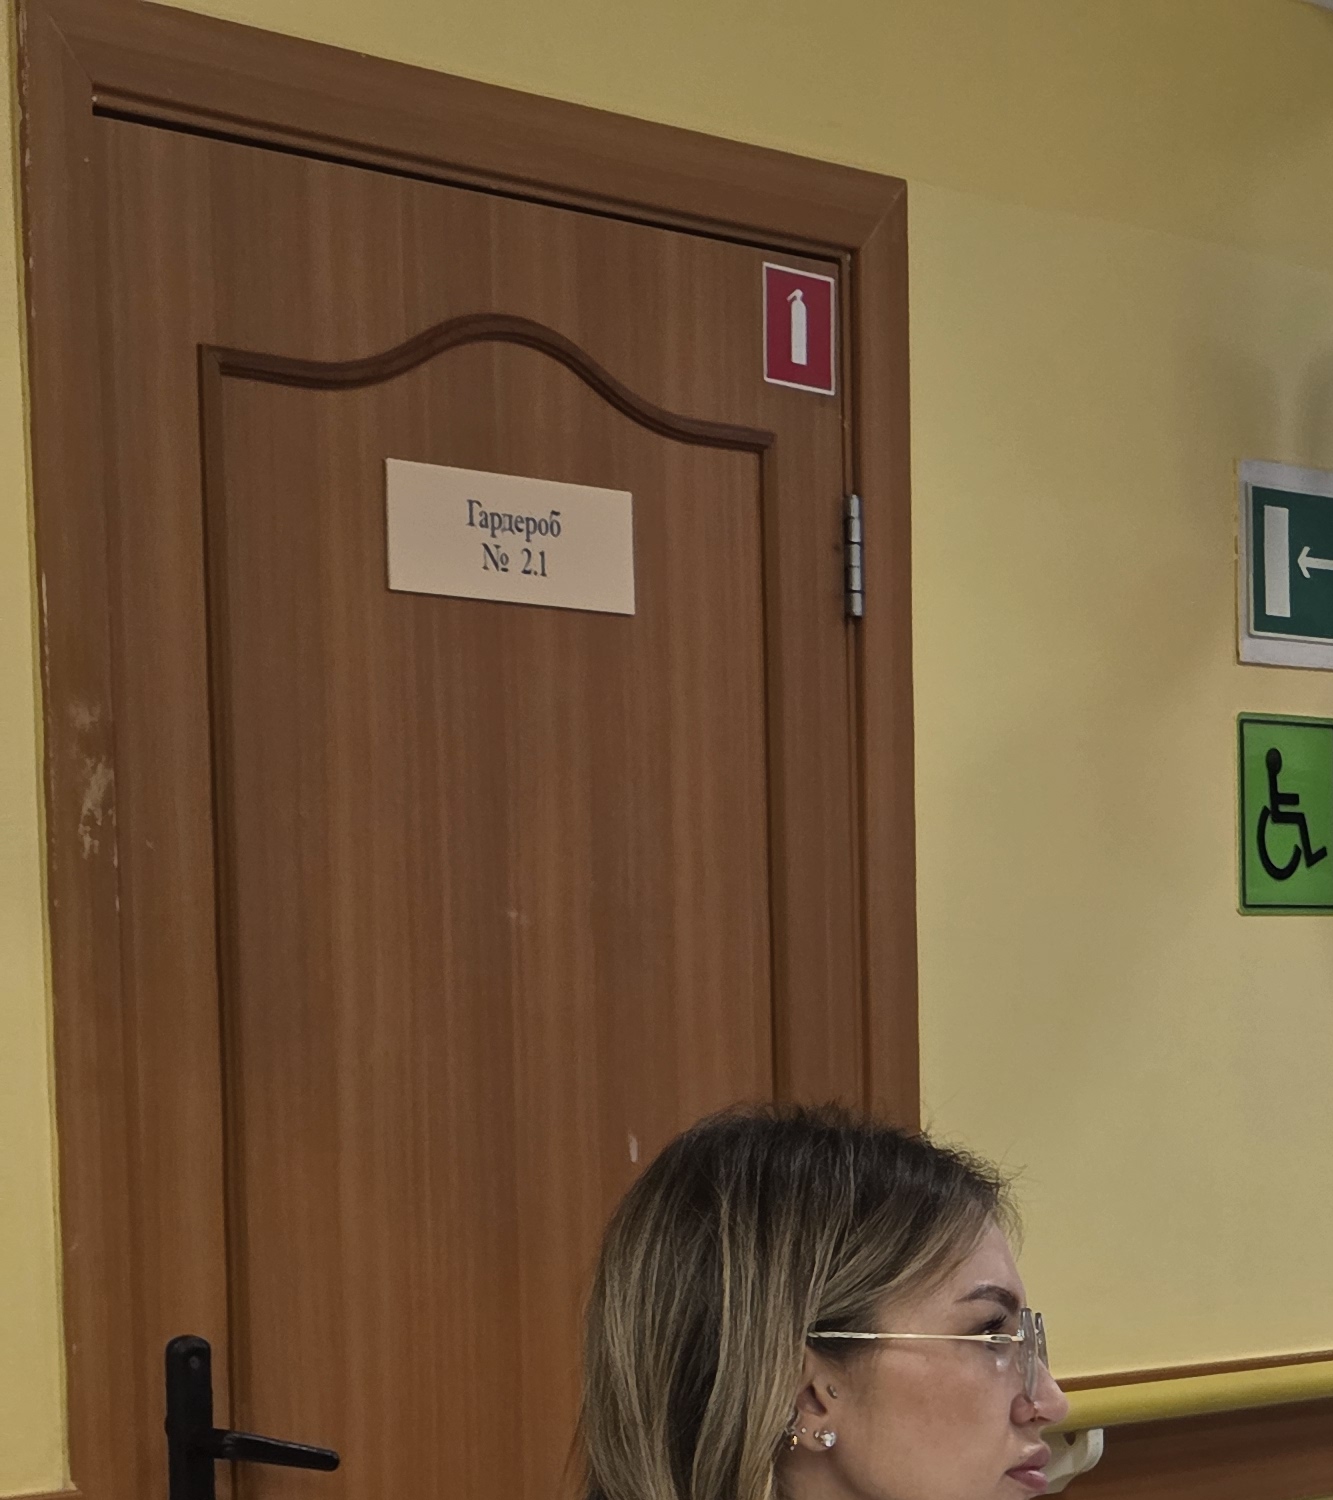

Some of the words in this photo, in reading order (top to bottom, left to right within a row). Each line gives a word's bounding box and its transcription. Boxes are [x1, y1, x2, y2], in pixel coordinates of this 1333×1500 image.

[466, 499, 562, 543] Гардероб
[481, 543, 510, 573] №
[520, 547, 548, 577] 2.1
